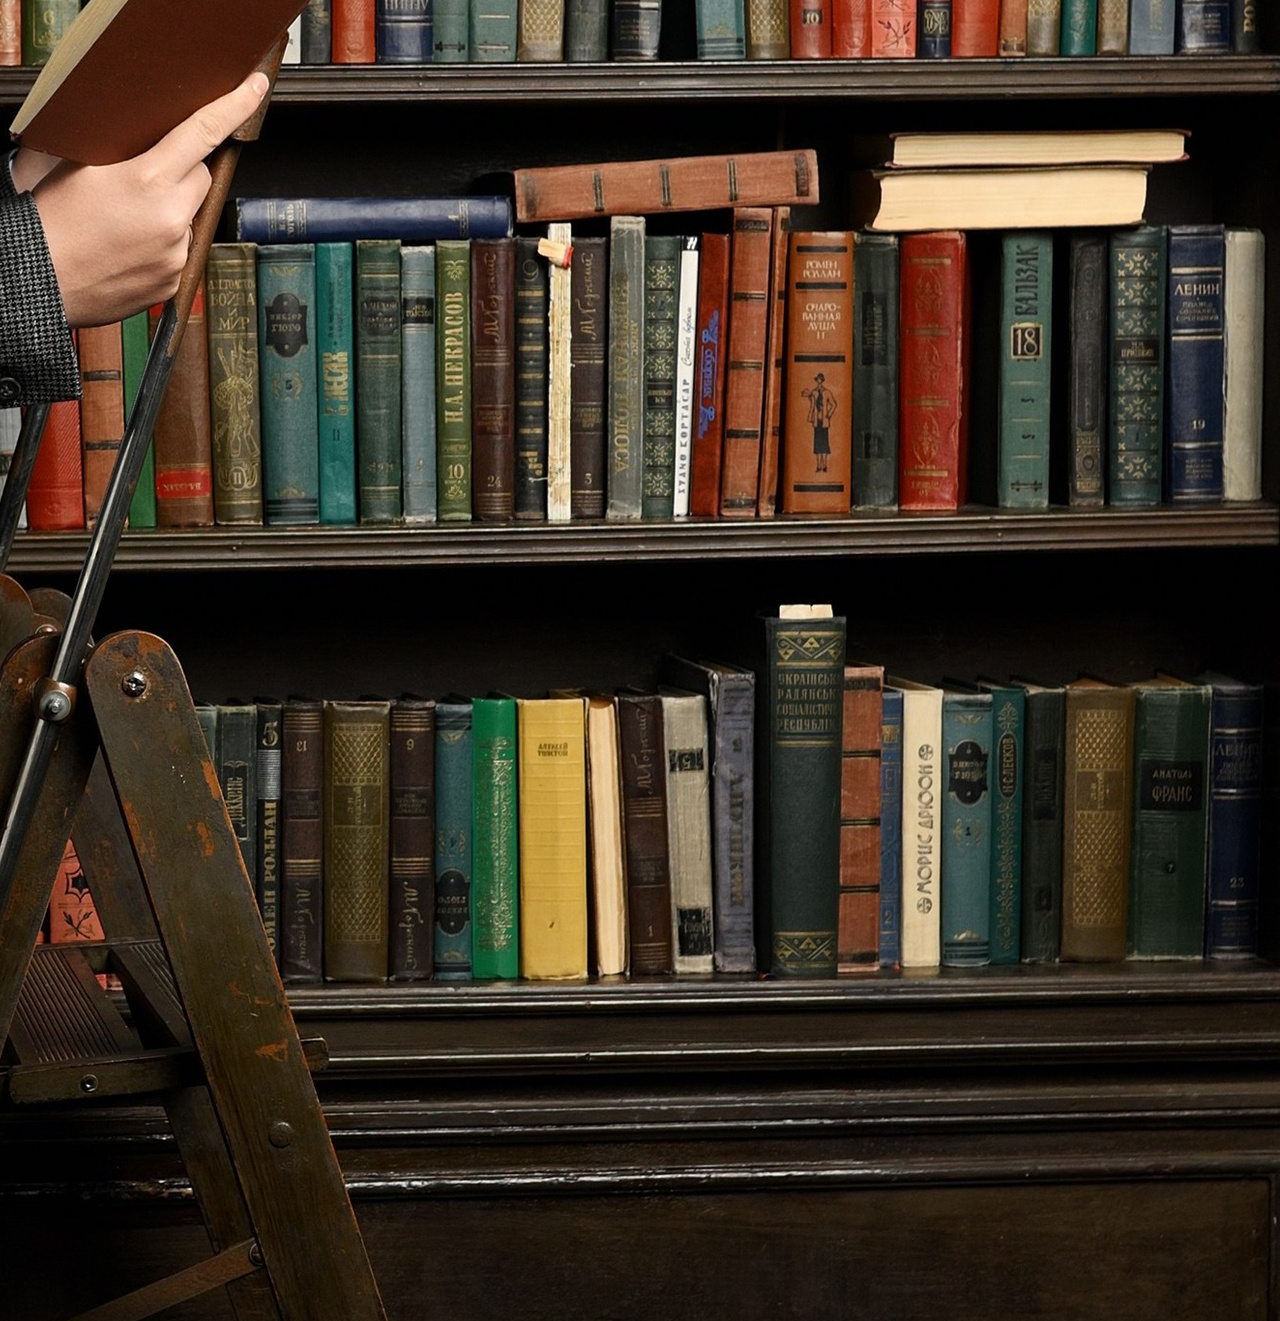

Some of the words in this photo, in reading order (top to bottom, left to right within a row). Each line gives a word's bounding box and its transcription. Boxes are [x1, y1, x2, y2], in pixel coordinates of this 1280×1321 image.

[805, 12, 820, 25] 10
[805, 260, 839, 270] РОМЕН
[802, 269, 842, 280] РОЛЛАН
[1014, 244, 1039, 317] БАЛЬЗАК
[1174, 282, 1221, 297] ЛЕНИН
[210, 290, 256, 307] ВОЙНА
[226, 306, 238, 318] И
[805, 302, 842, 312] ОЧАРО-
[801, 311, 842, 322] ВАННАЯ
[218, 317, 251, 331] МИР
[270, 323, 303, 334] ГЮГО
[806, 321, 837, 332] ДУША
[443, 290, 465, 386] НЕКРАСОВ
[1013, 327, 1039, 357] 18
[701, 347, 717, 399] сборник
[283, 378, 293, 392] 5
[443, 389, 465, 424] Н.А.
[679, 378, 691, 448] КОРТАСАР
[1190, 419, 1207, 430] 19
[612, 390, 631, 474] ПОЛОСА
[446, 463, 466, 479] 10
[678, 452, 688, 495] ХУЛИО
[486, 474, 503, 487] 24
[261, 721, 278, 748] 5
[296, 740, 308, 753] 13
[537, 741, 569, 750] АЛЕКСЕЙ
[537, 749, 569, 758] ТОЛСТОЙ
[1151, 768, 1193, 780] АНАТОЛЬ
[916, 764, 934, 829] ДРЮОН
[1151, 785, 1193, 803] ФРАНС
[223, 776, 245, 829] Диккенс
[964, 825, 972, 837] 1
[262, 801, 278, 883] РОЛЛАН
[916, 834, 934, 894] МОРИС
[1228, 876, 1246, 890] 23
[261, 889, 278, 952] ОМЕН
[884, 911, 893, 924] 2
[646, 925, 655, 938] 1
[1003, 926, 1011, 938] 3
